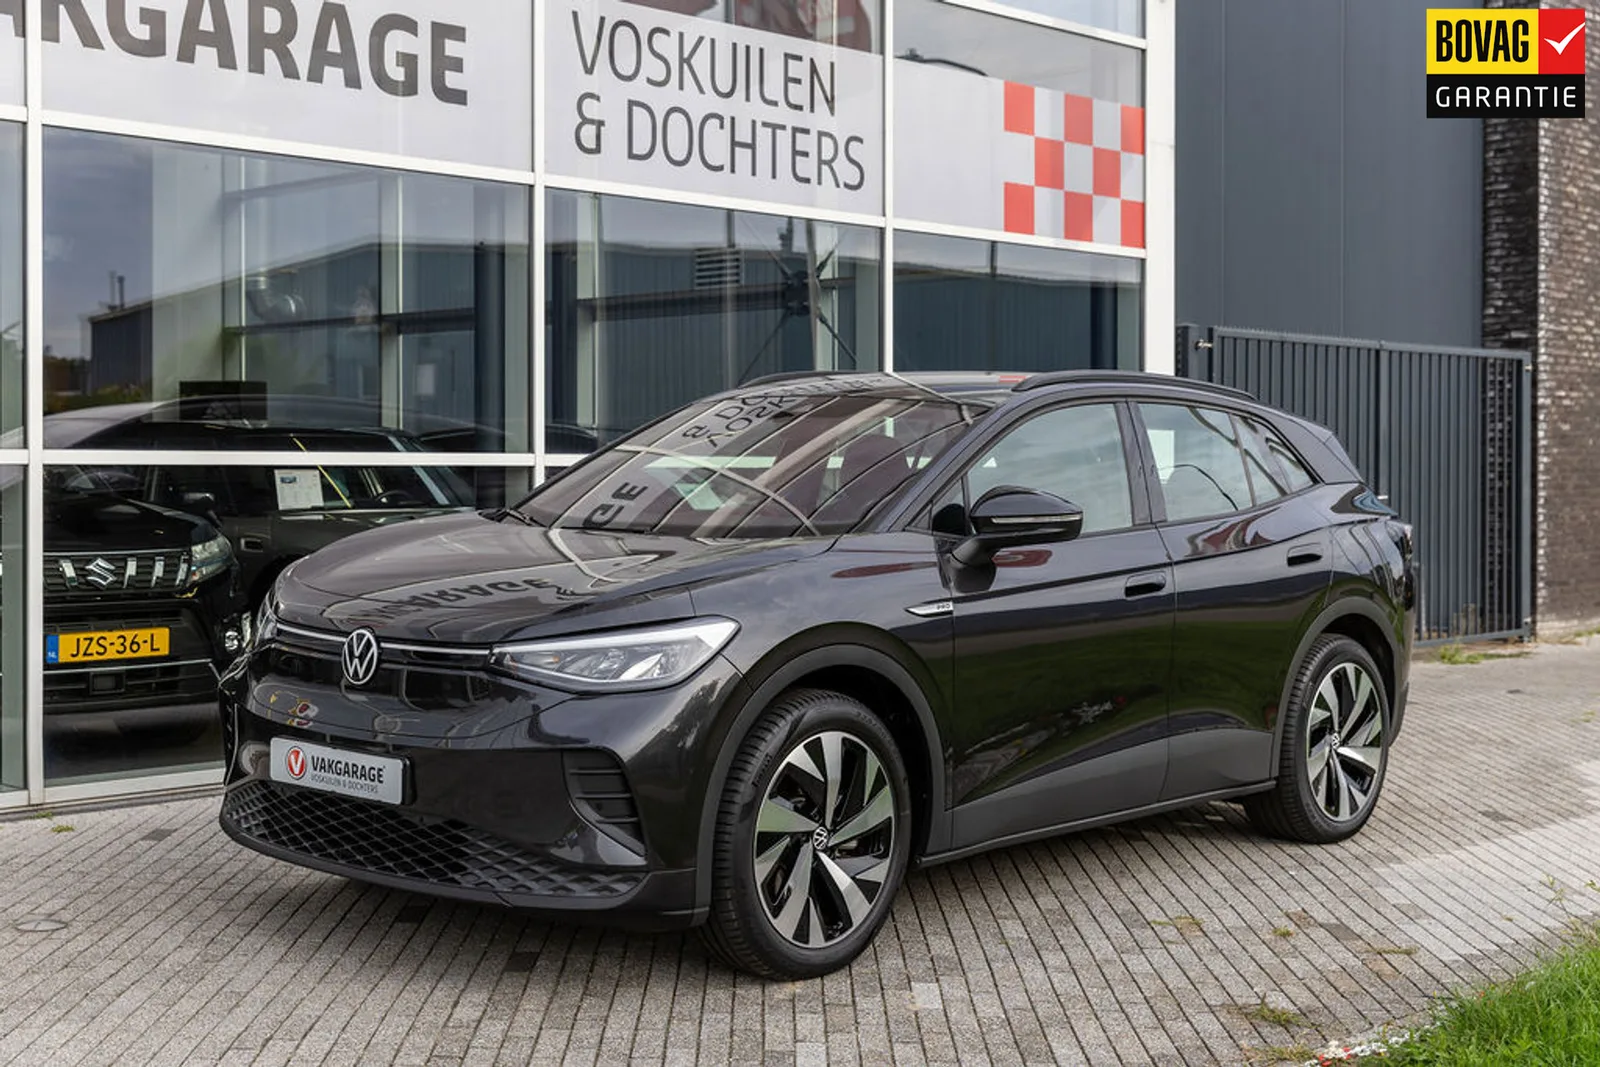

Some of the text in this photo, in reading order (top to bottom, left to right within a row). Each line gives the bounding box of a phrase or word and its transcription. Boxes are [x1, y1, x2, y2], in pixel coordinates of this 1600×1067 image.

[572, 10, 836, 117] VOSKUILEN
[574, 91, 865, 191] & DOCHTERS
[70, 633, 160, 657] JZS-36-L
[311, 755, 385, 784] VAKGARAGE
